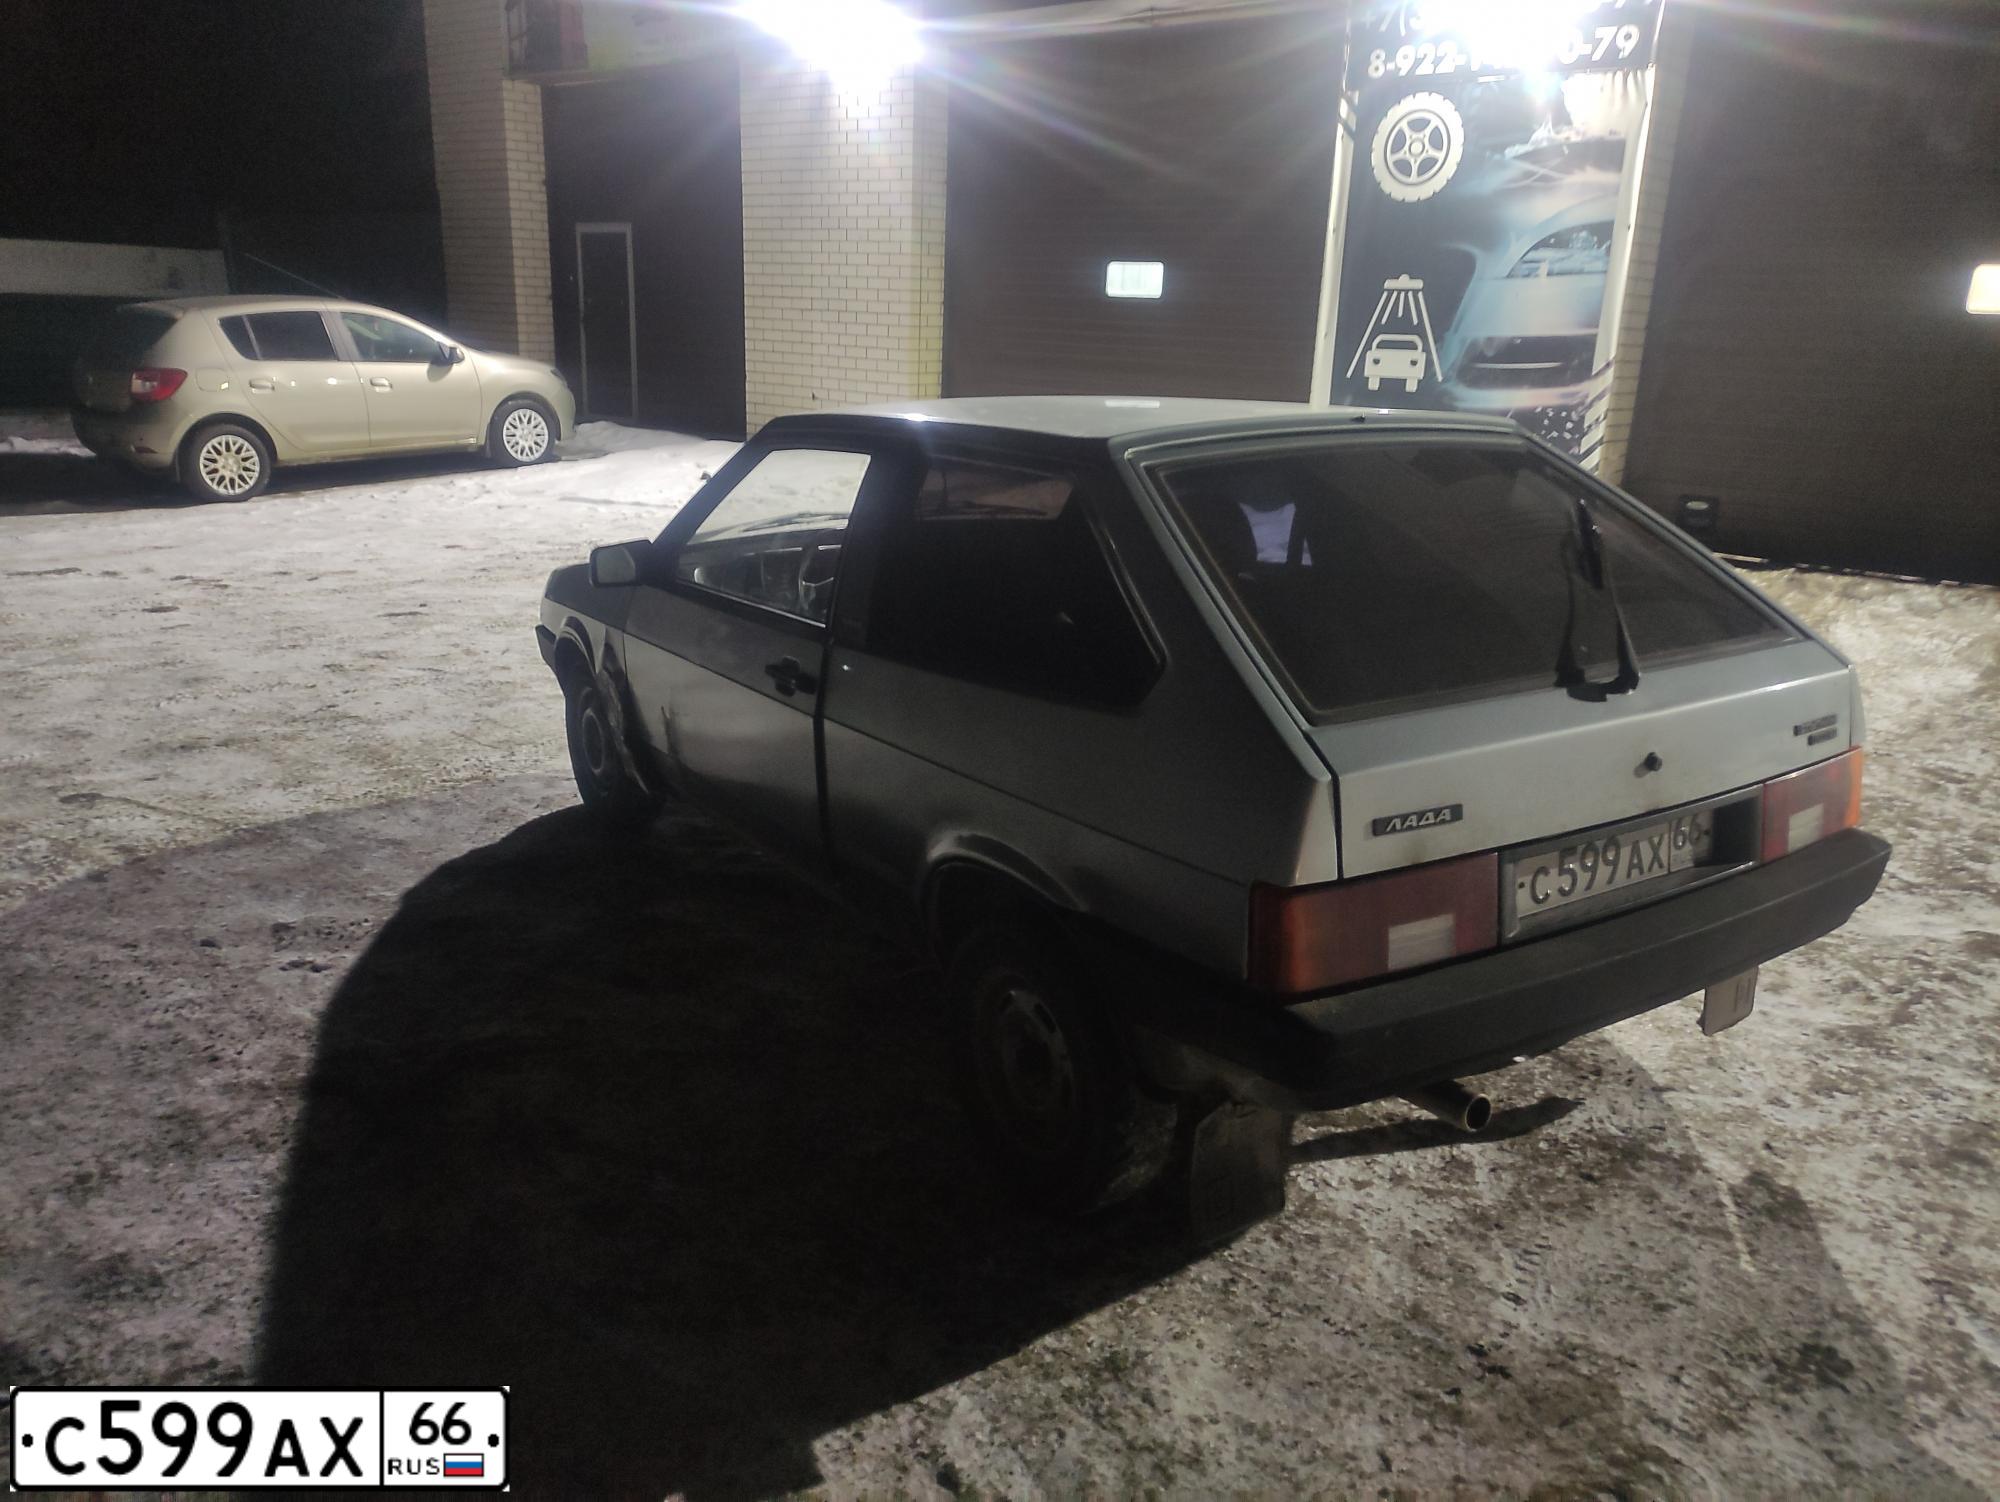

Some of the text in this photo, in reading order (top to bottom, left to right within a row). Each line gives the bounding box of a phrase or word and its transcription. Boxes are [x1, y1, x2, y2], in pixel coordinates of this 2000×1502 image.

[1385, 808, 1452, 832] ЛАДА
[1530, 812, 1701, 904] С599АХ 66
